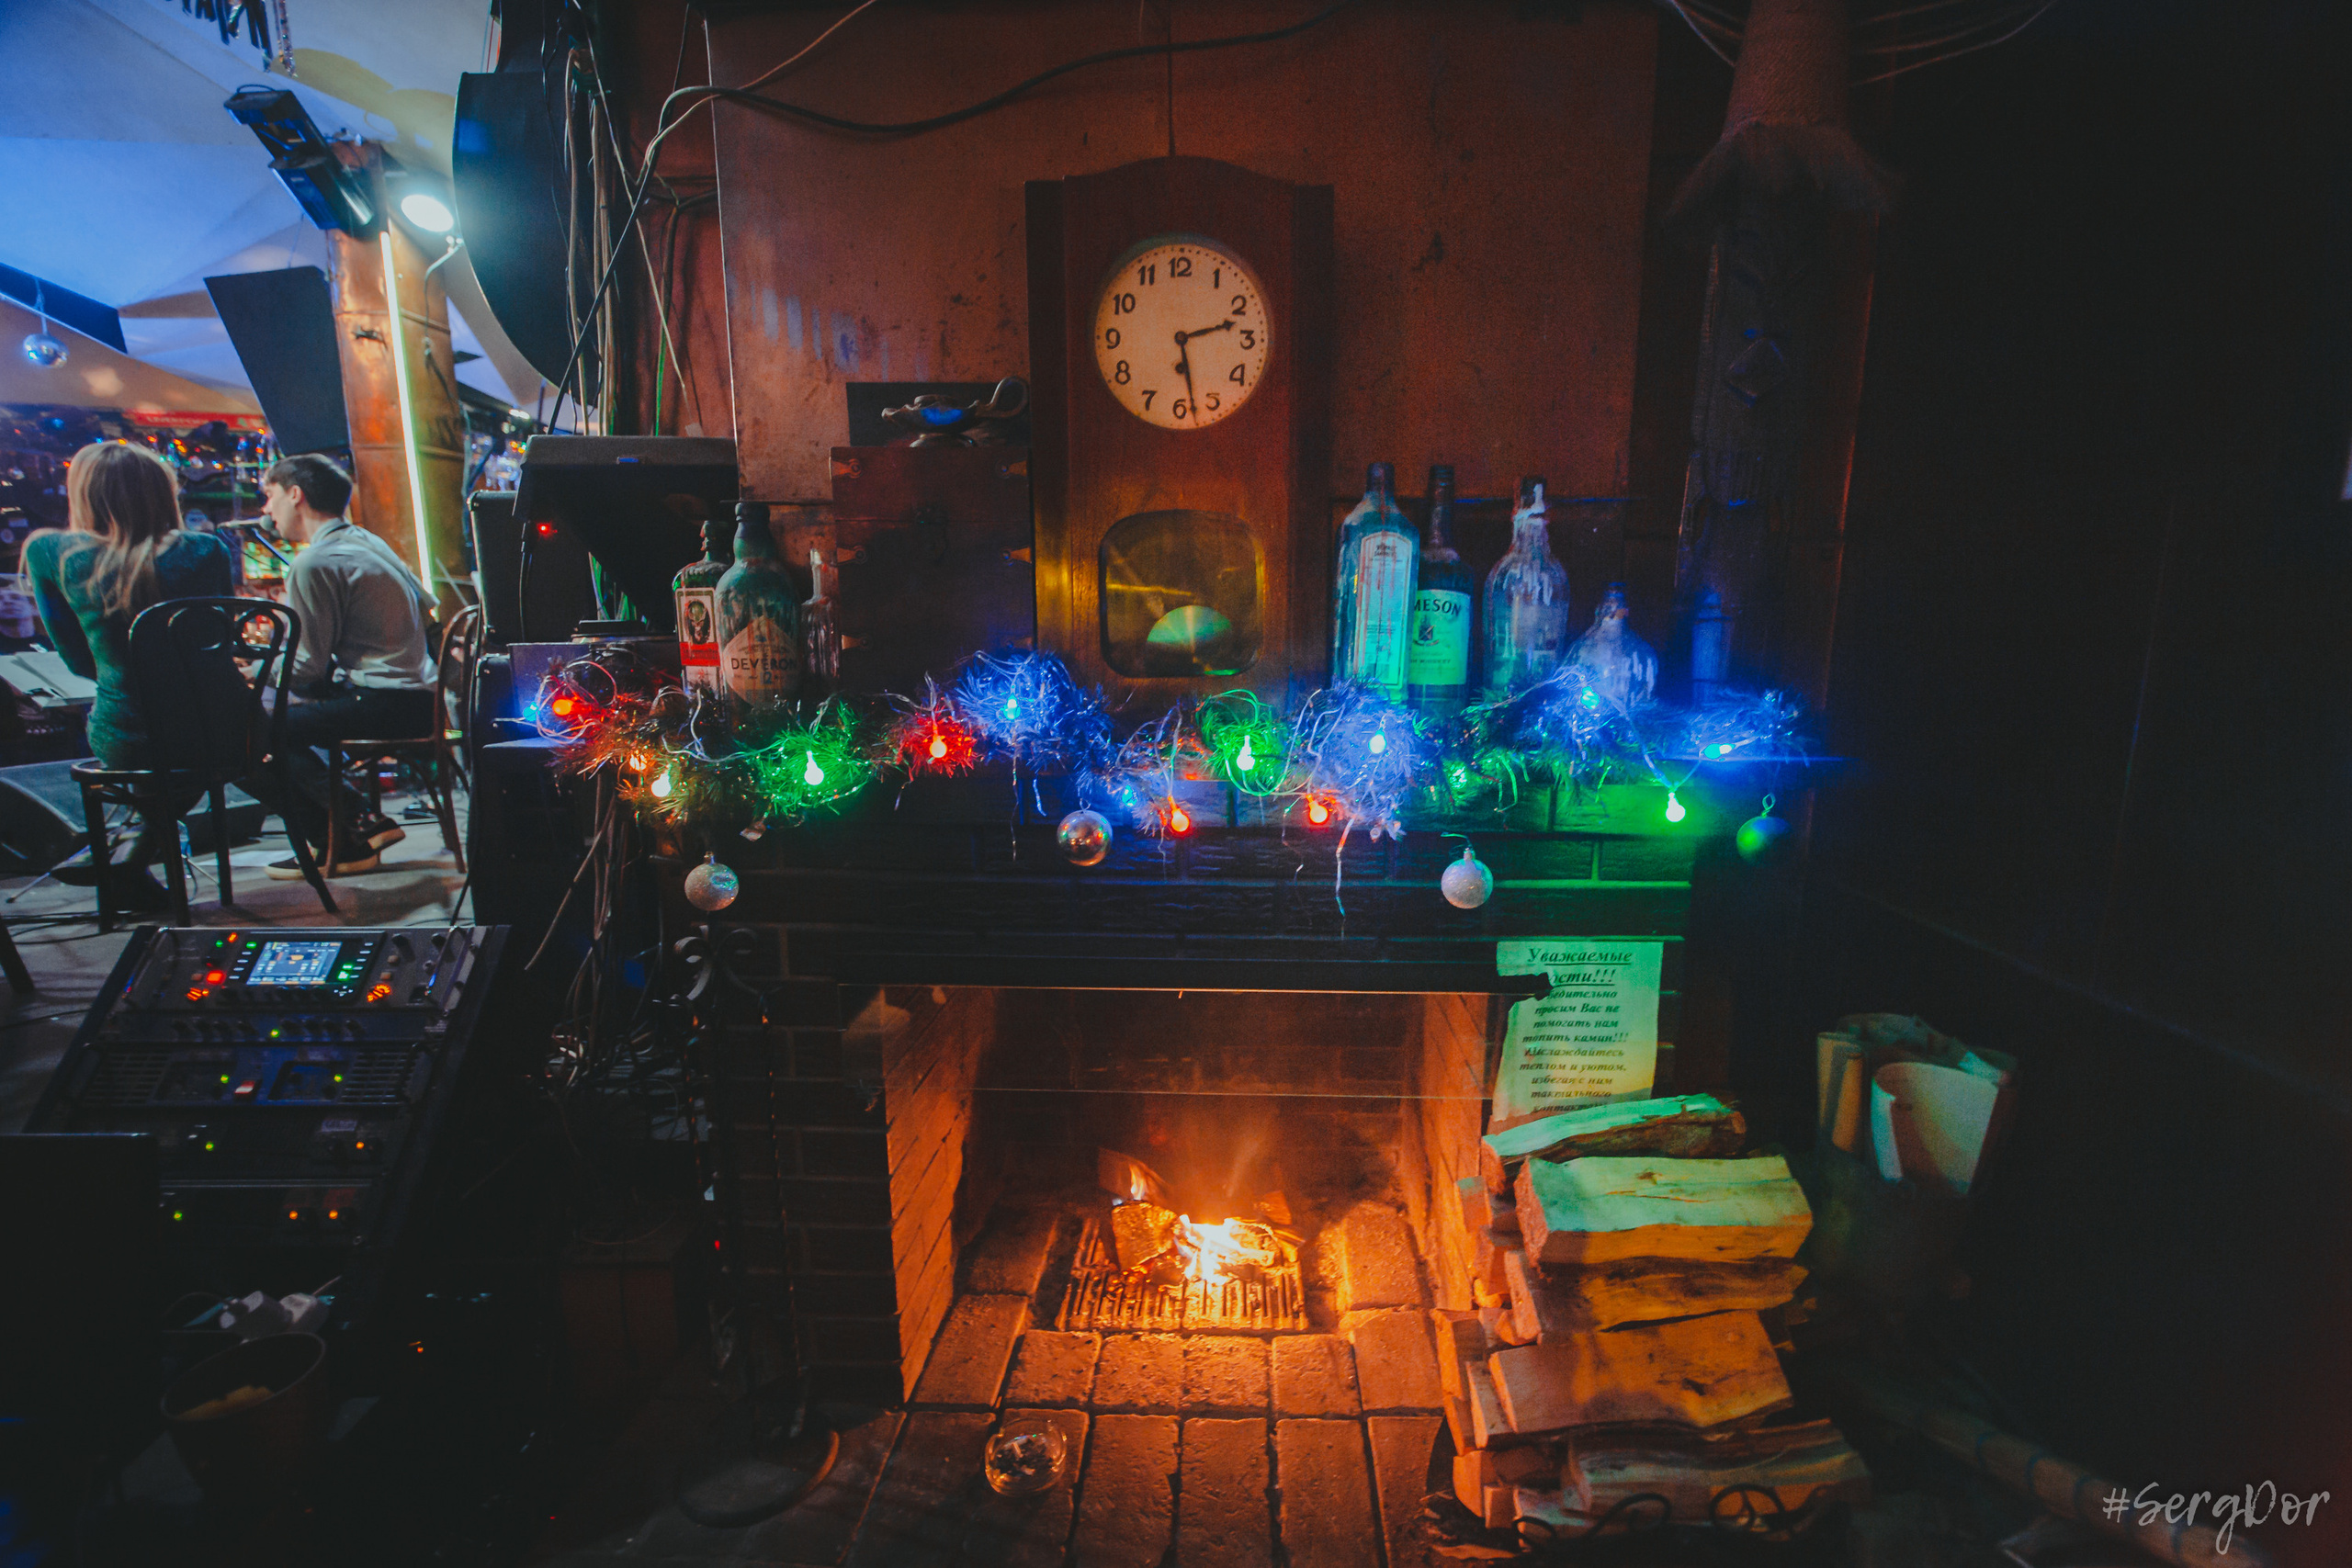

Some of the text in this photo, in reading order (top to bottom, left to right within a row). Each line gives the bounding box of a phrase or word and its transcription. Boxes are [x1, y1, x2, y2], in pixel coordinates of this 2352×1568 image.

[1137, 265, 1156, 287] 11
[1169, 256, 1193, 278] 12
[1213, 267, 1221, 290] 1
[1113, 293, 1136, 315] 10
[1231, 295, 1247, 316] 2
[1105, 328, 1121, 350] 9
[1239, 330, 1256, 350] 3
[1114, 360, 1131, 386] 8
[1228, 363, 1246, 387] 4
[1141, 389, 1158, 412] 7
[1172, 399, 1188, 420] 6
[1205, 392, 1221, 412] 5
[1413, 598, 1462, 617] MESON
[1527, 948, 1633, 963] Уважаемые
[1553, 968, 1617, 984] ости!!!
[1535, 1002, 1620, 1017] просим Вас не
[1533, 1020, 1619, 1029] помогать нам
[1521, 1033, 1571, 1043] топить
[1519, 1062, 1566, 1071] теплом
[1569, 1063, 1577, 1071] и
[1531, 1074, 1575, 1085] избегая
[1588, 1077, 1612, 1085] ним
[1531, 1090, 1612, 1099] тактильного
